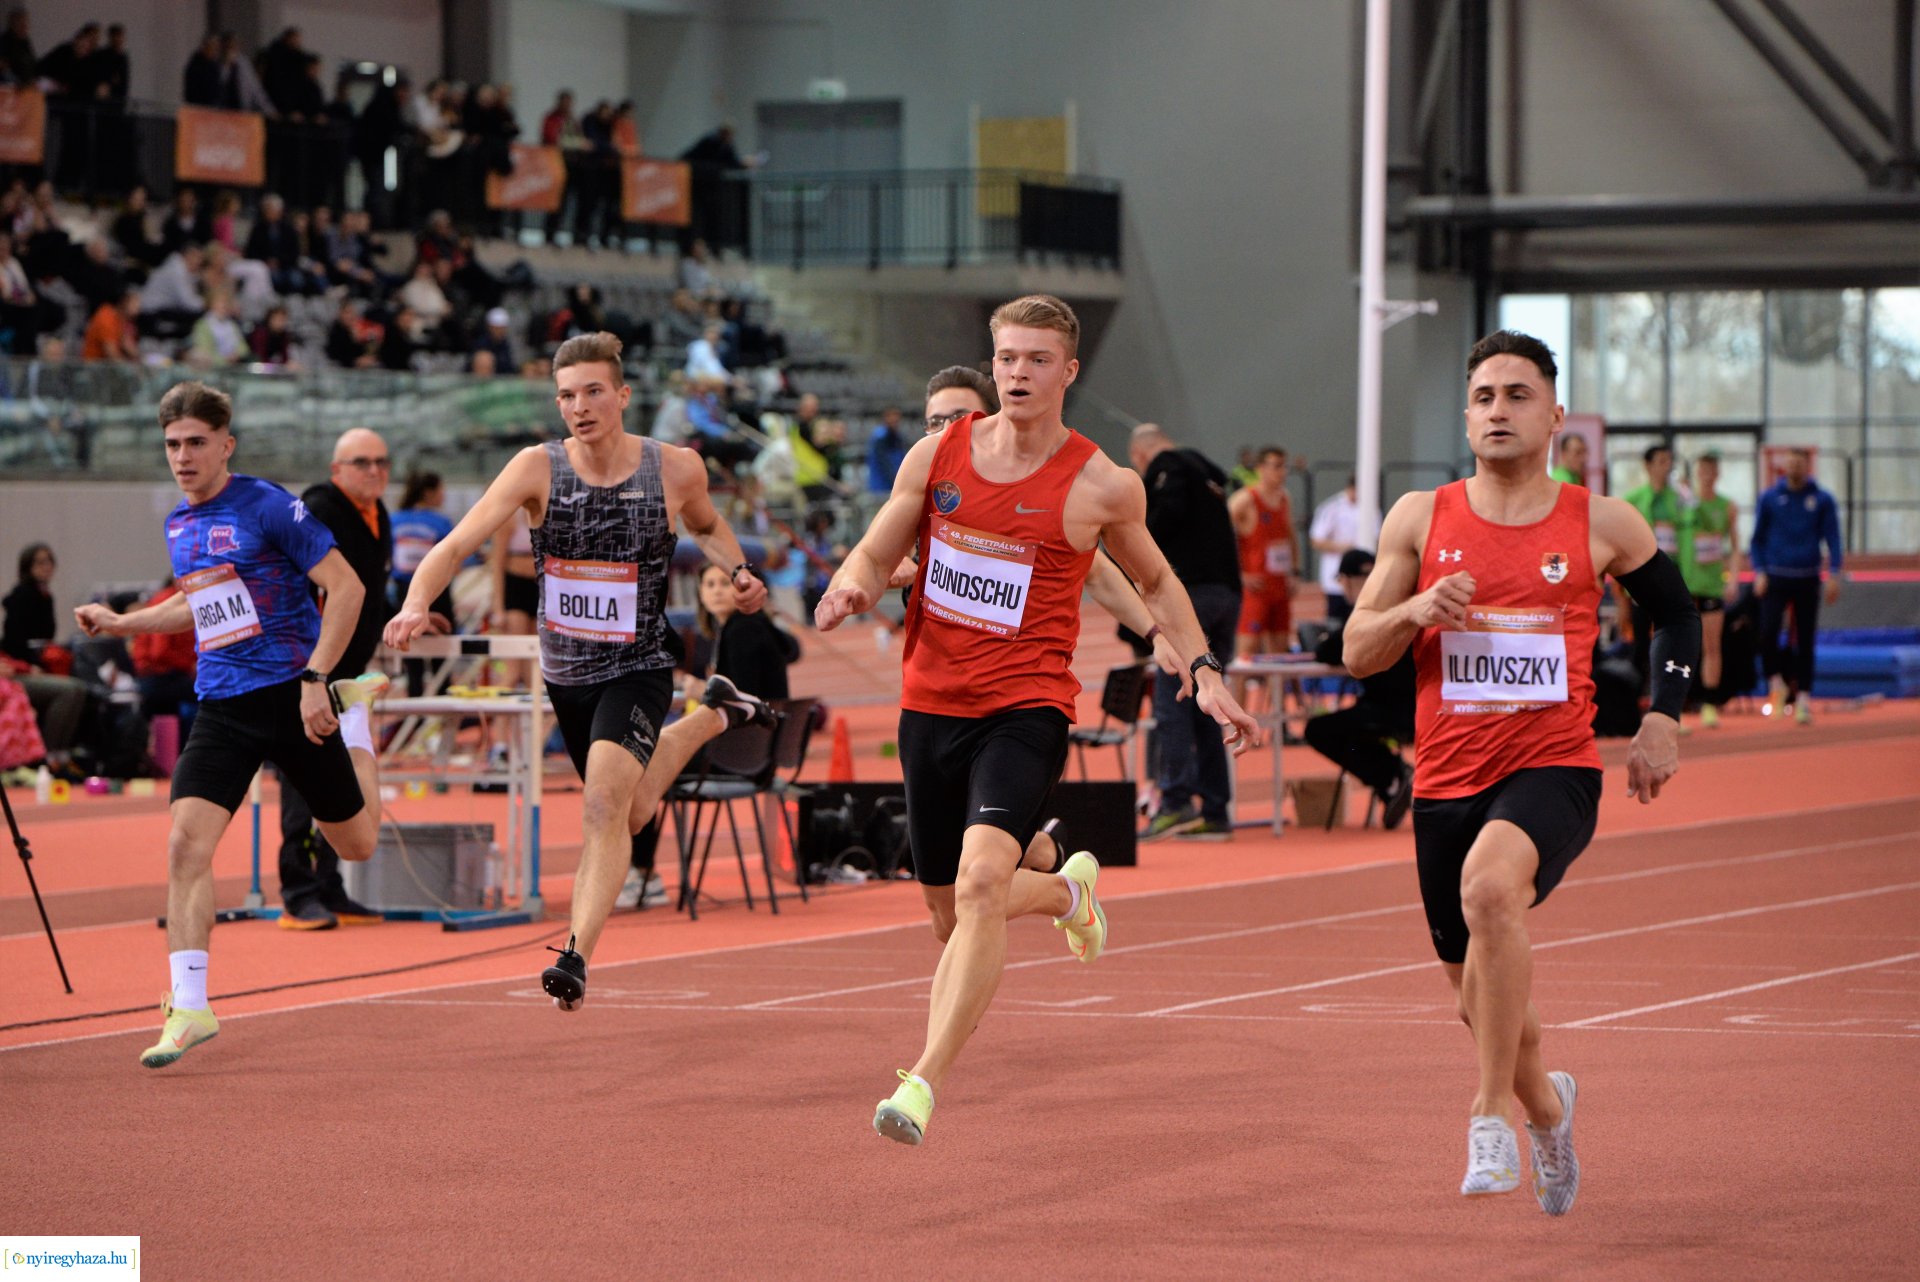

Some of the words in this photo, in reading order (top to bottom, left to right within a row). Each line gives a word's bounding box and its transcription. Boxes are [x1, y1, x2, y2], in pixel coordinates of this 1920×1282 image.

[950, 531, 961, 540] 49.
[963, 534, 1026, 553] FEDETTPÁLYÁS
[930, 559, 1022, 610] BUNDSCHU
[196, 601, 227, 630] ARGA
[227, 594, 250, 619] M.
[559, 593, 618, 621] BOLLA
[927, 603, 983, 629] NYÍREGYHÁZA
[985, 624, 1008, 635] 2023
[1448, 655, 1560, 685] ILLOVSZKY
